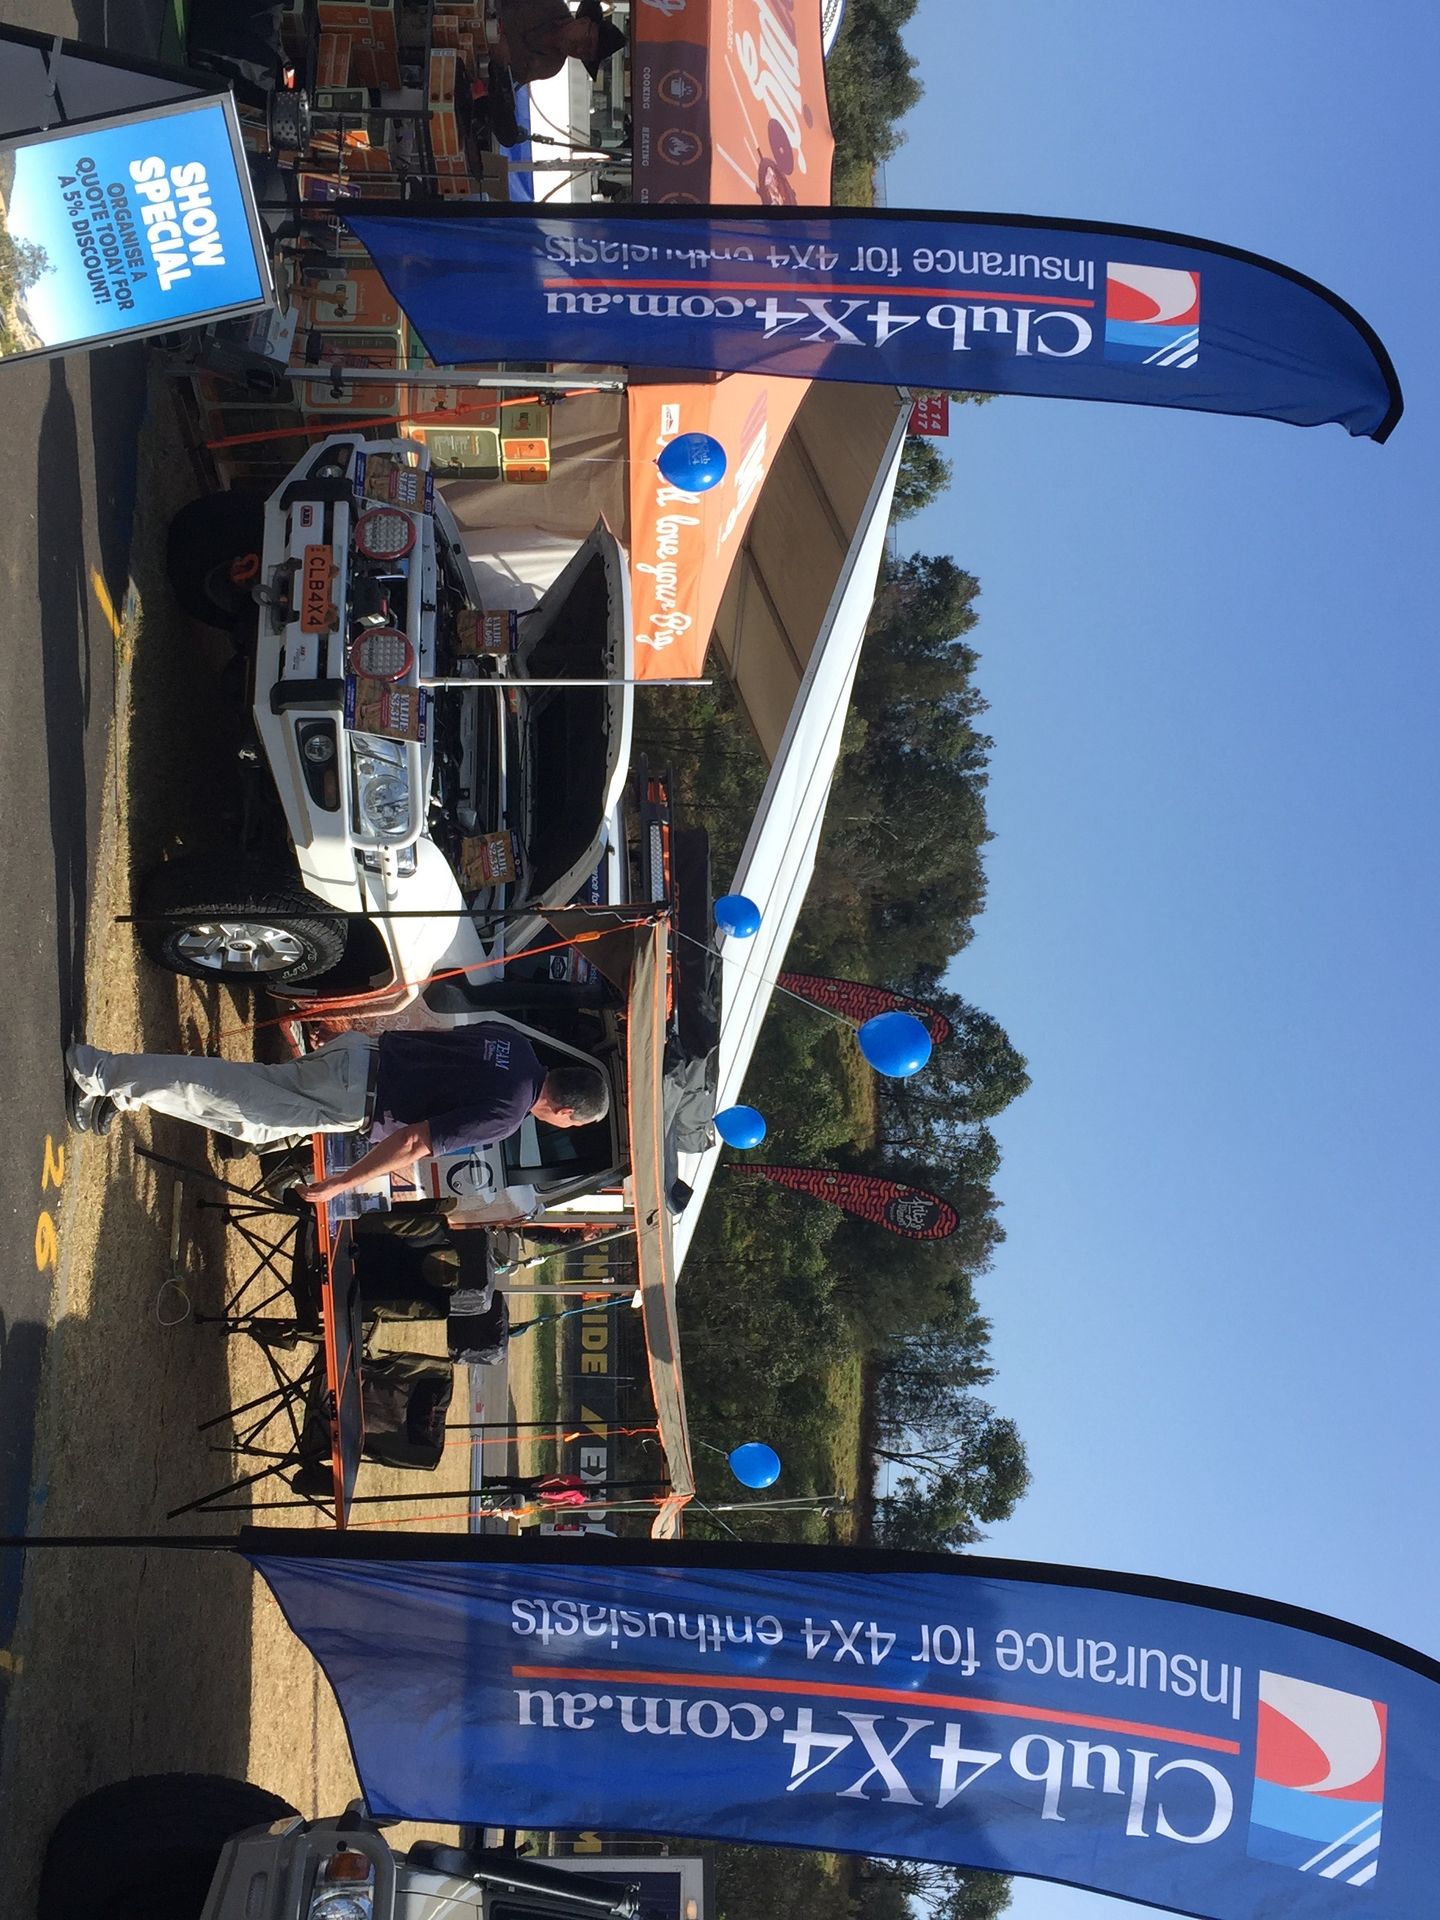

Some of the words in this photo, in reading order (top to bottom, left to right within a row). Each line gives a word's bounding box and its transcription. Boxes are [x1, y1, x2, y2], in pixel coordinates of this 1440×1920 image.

[642, 66, 651, 110] COOKING
[641, 126, 650, 167] HEATING
[57, 175, 77, 189] A
[62, 190, 85, 217] 5%
[75, 157, 109, 222] QUOTE
[95, 222, 127, 276] TODAY
[111, 278, 135, 312] FOR
[106, 182, 145, 269] ORGANISE
[130, 271, 148, 283] A
[128, 156, 192, 292] SPECIAL
[169, 161, 226, 267] SHOW
[71, 219, 113, 306] DISCOUNT!
[766, 244, 839, 271] 4X4
[849, 245, 902, 278] for
[912, 247, 1094, 290] Insurance
[931, 412, 942, 430] 14
[655, 514, 700, 560] love
[306, 556, 326, 626] CLB4X4
[635, 562, 678, 610] your
[635, 611, 693, 651] Big
[495, 1039, 511, 1071] TEAM
[511, 1599, 784, 1653] enthusiasts
[801, 1617, 897, 1665] 4X4
[912, 1624, 980, 1677] for
[996, 1629, 1242, 1720] Insurance
